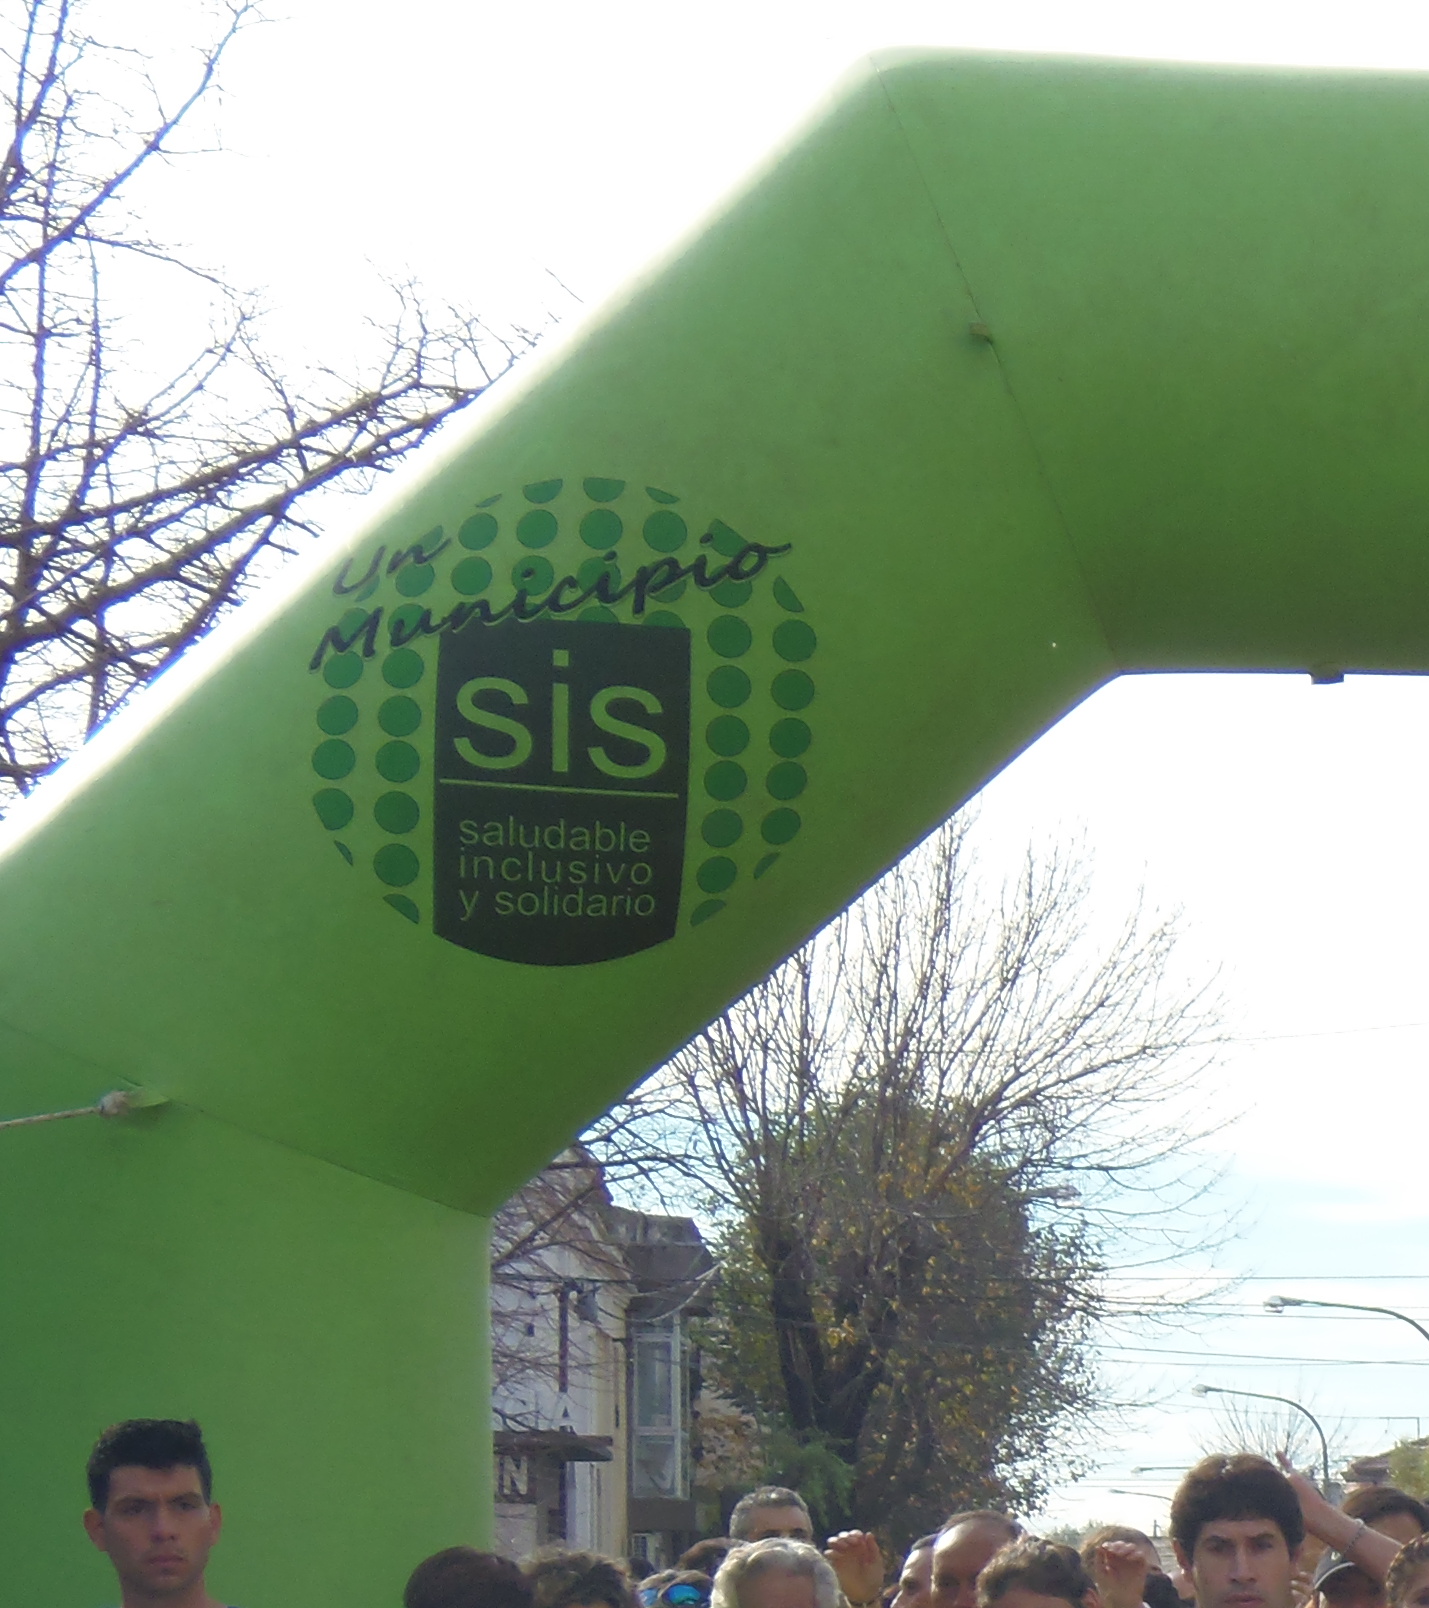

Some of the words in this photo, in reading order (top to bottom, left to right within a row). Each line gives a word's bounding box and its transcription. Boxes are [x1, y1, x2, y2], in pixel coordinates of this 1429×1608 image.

[333, 537, 451, 594] Un
[308, 533, 792, 671] Municipio
[453, 649, 667, 779] sis
[459, 815, 651, 854] saludable
[459, 850, 652, 885] inclusivo
[459, 890, 480, 921] y
[494, 886, 656, 917] solidario
